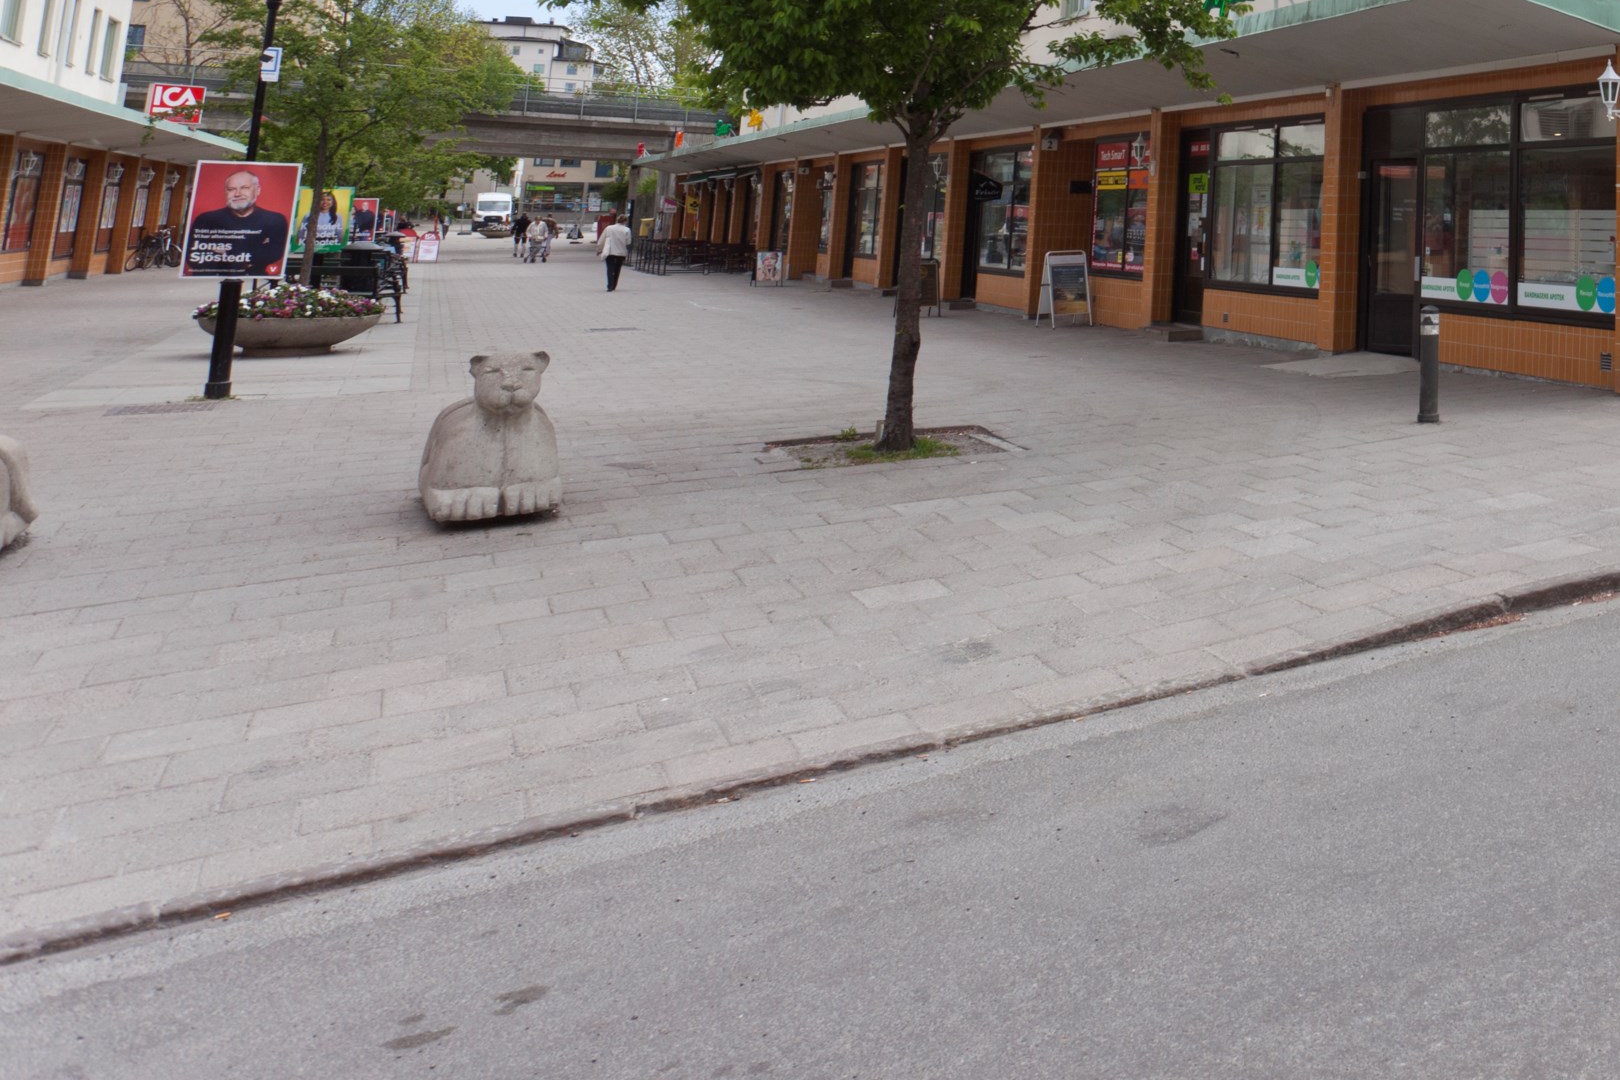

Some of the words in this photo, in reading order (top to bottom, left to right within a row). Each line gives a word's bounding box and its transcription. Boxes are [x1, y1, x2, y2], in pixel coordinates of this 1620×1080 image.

[153, 85, 197, 107] ICA
[191, 240, 233, 251] Jonas
[189, 252, 252, 264] Sjöstedt
